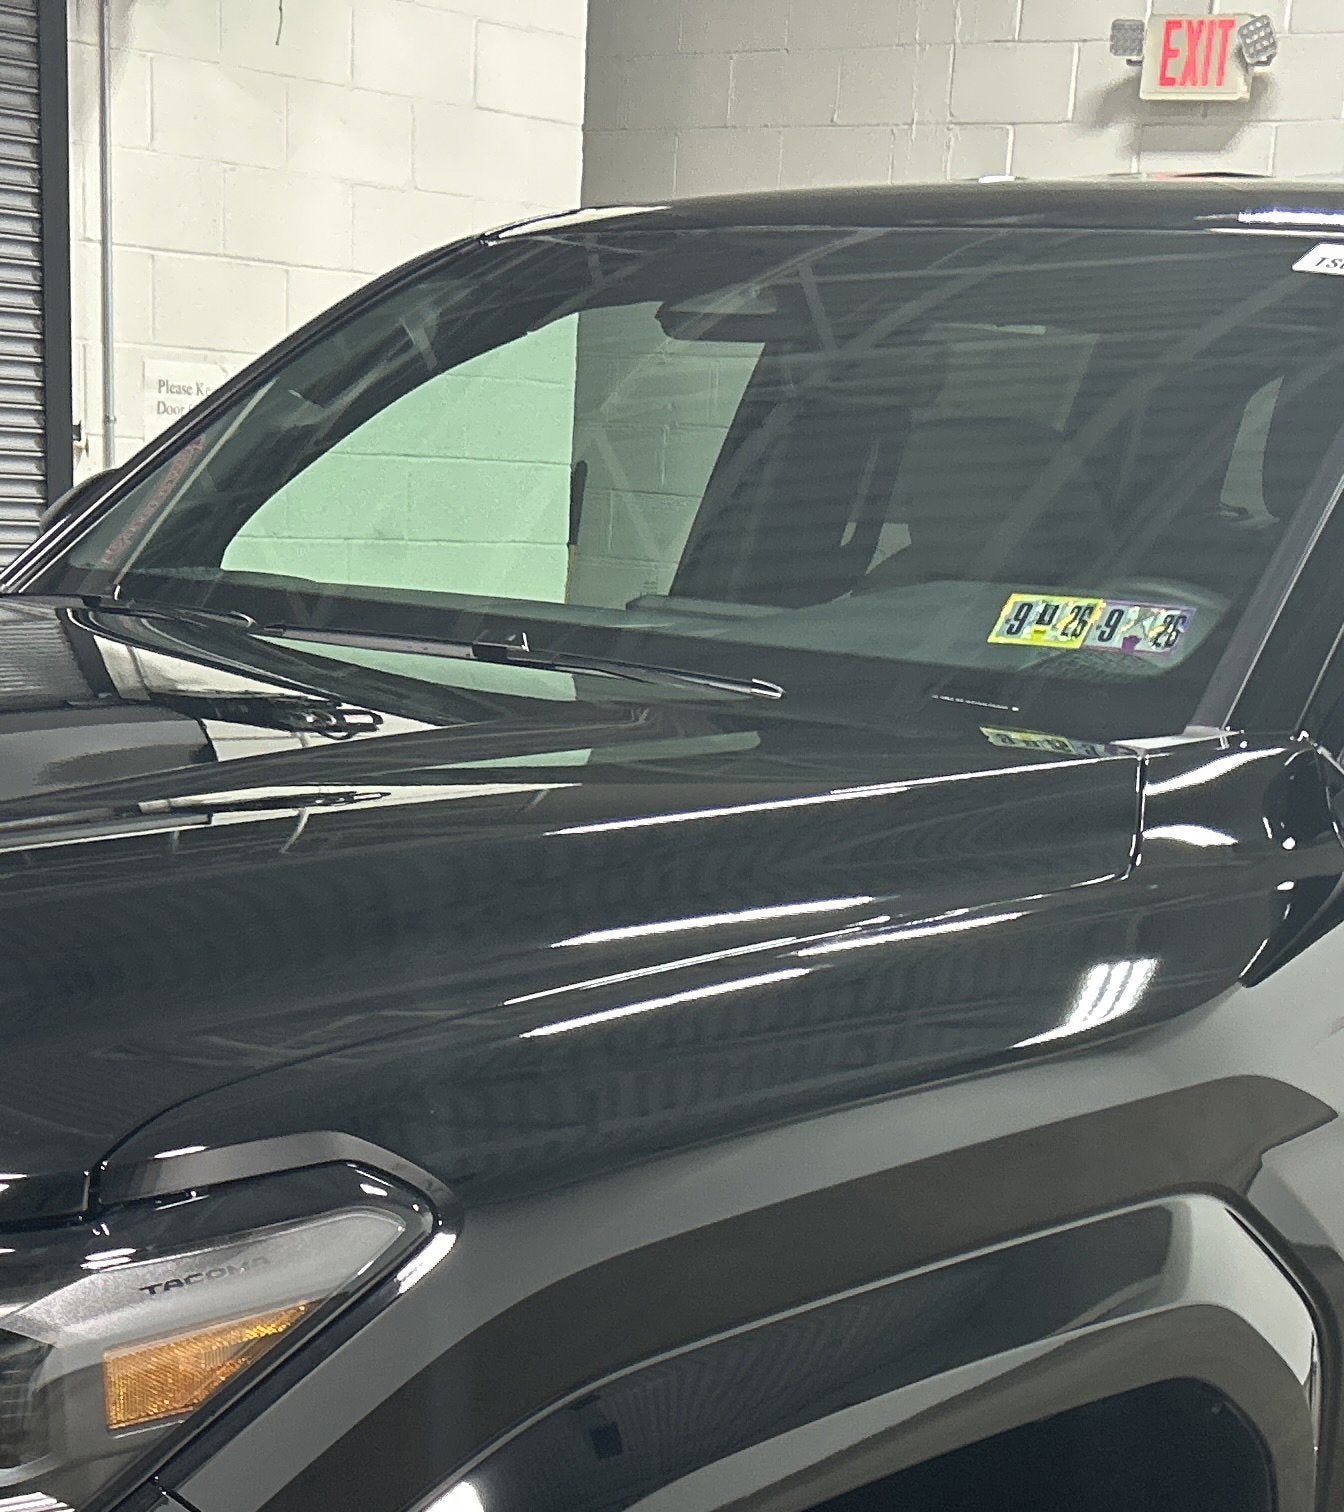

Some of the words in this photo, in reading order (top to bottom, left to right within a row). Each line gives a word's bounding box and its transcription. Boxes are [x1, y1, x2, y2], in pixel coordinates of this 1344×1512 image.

[1159, 18, 1236, 87] EXIT
[158, 378, 193, 396] Please
[195, 381, 212, 397] Ke
[156, 400, 184, 416] Door
[1006, 602, 1034, 636] 9
[1097, 608, 1125, 643] 9
[139, 1256, 271, 1295] TACOMA
